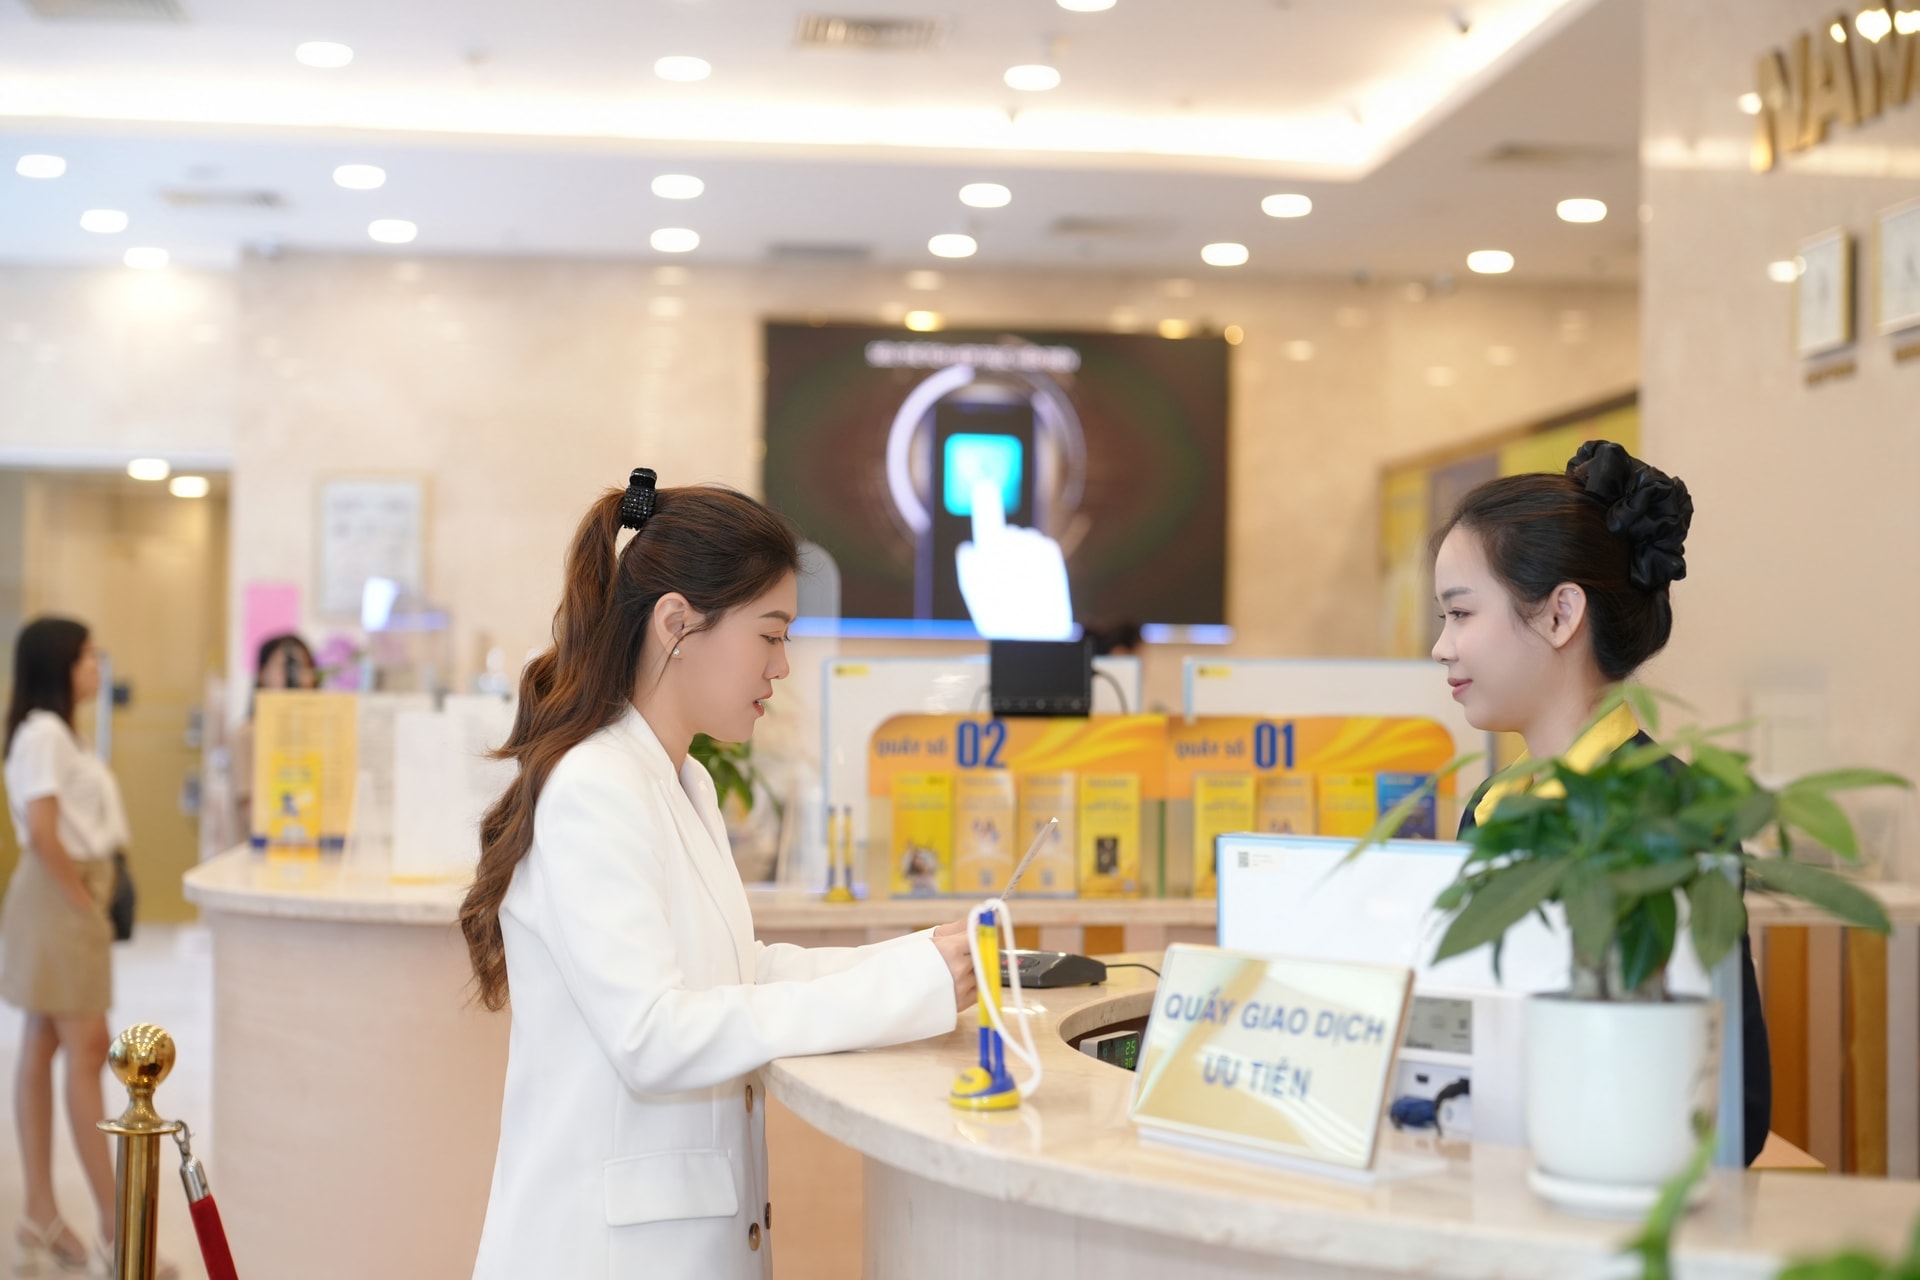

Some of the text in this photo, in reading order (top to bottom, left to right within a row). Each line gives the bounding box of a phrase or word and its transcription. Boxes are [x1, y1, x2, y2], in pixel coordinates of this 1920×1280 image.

[957, 720, 1007, 769] 02
[1254, 720, 1294, 769] 01
[1240, 1001, 1309, 1036] GIAO
[1314, 1011, 1385, 1046] DỊCH
